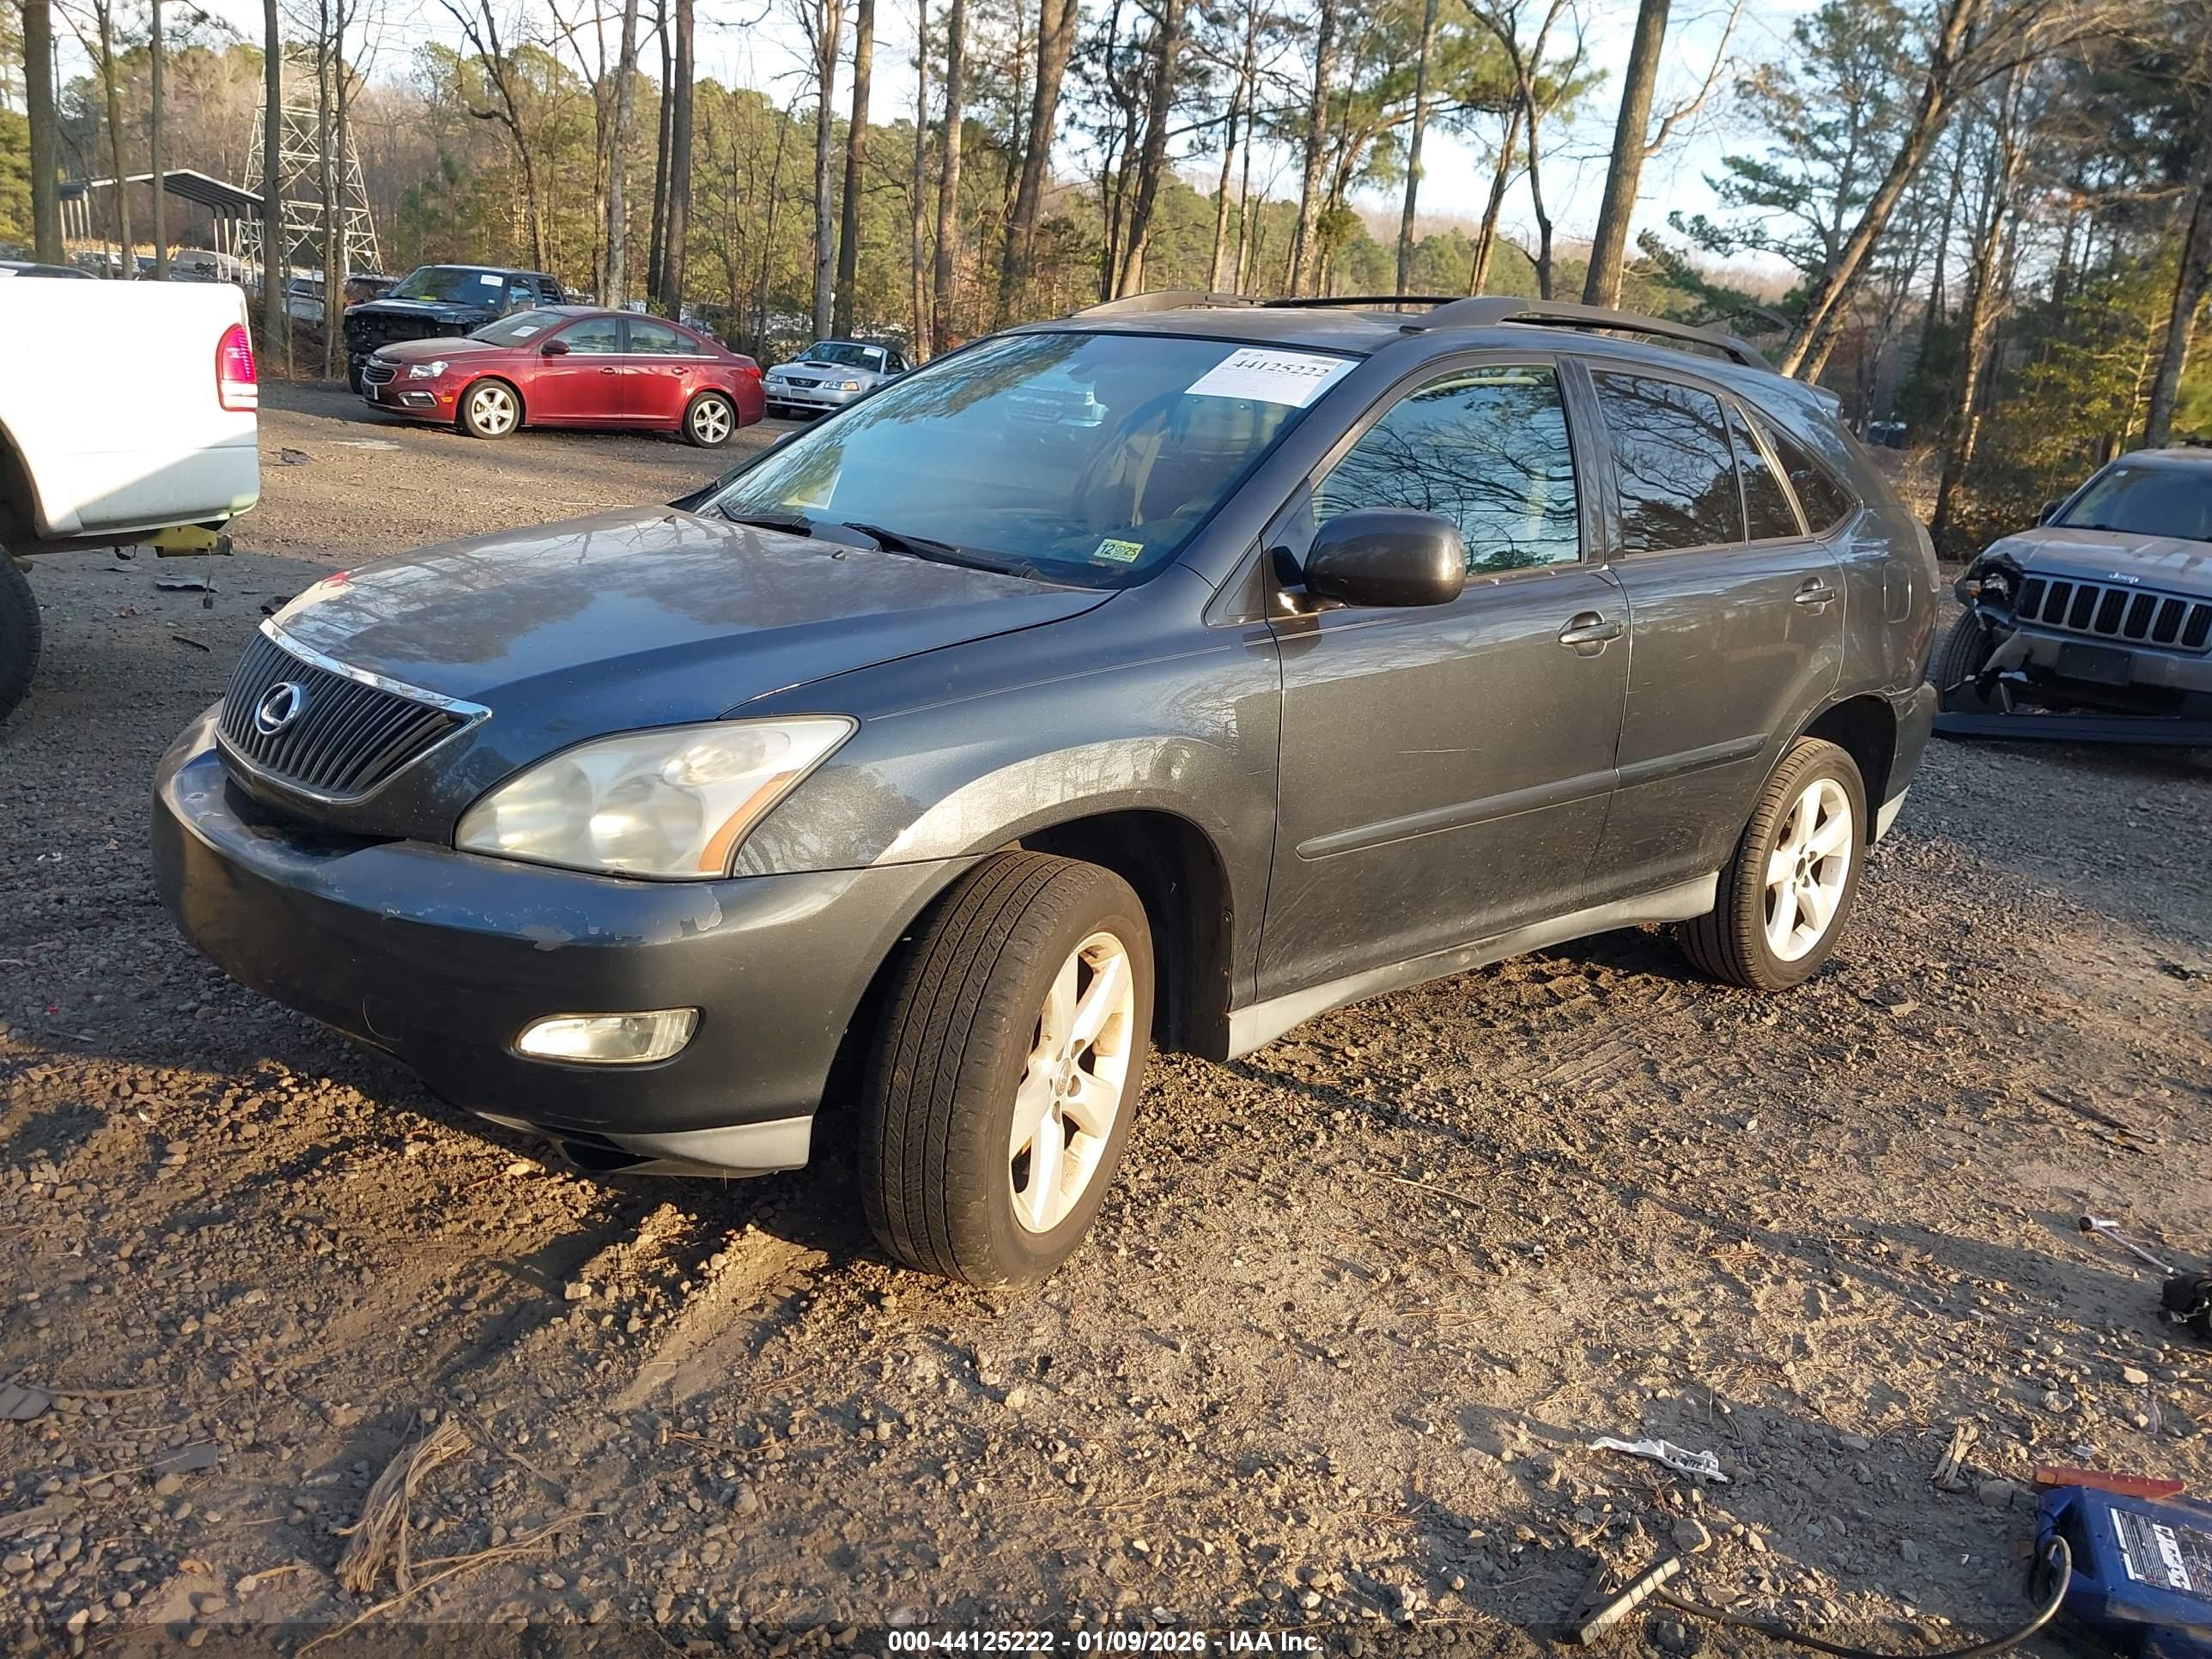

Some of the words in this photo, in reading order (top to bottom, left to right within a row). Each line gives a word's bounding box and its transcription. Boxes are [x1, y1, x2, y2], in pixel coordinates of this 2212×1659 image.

[1232, 359, 1330, 378] 44125222
[1100, 542, 1115, 555] 12
[1125, 546, 1139, 556] 25
